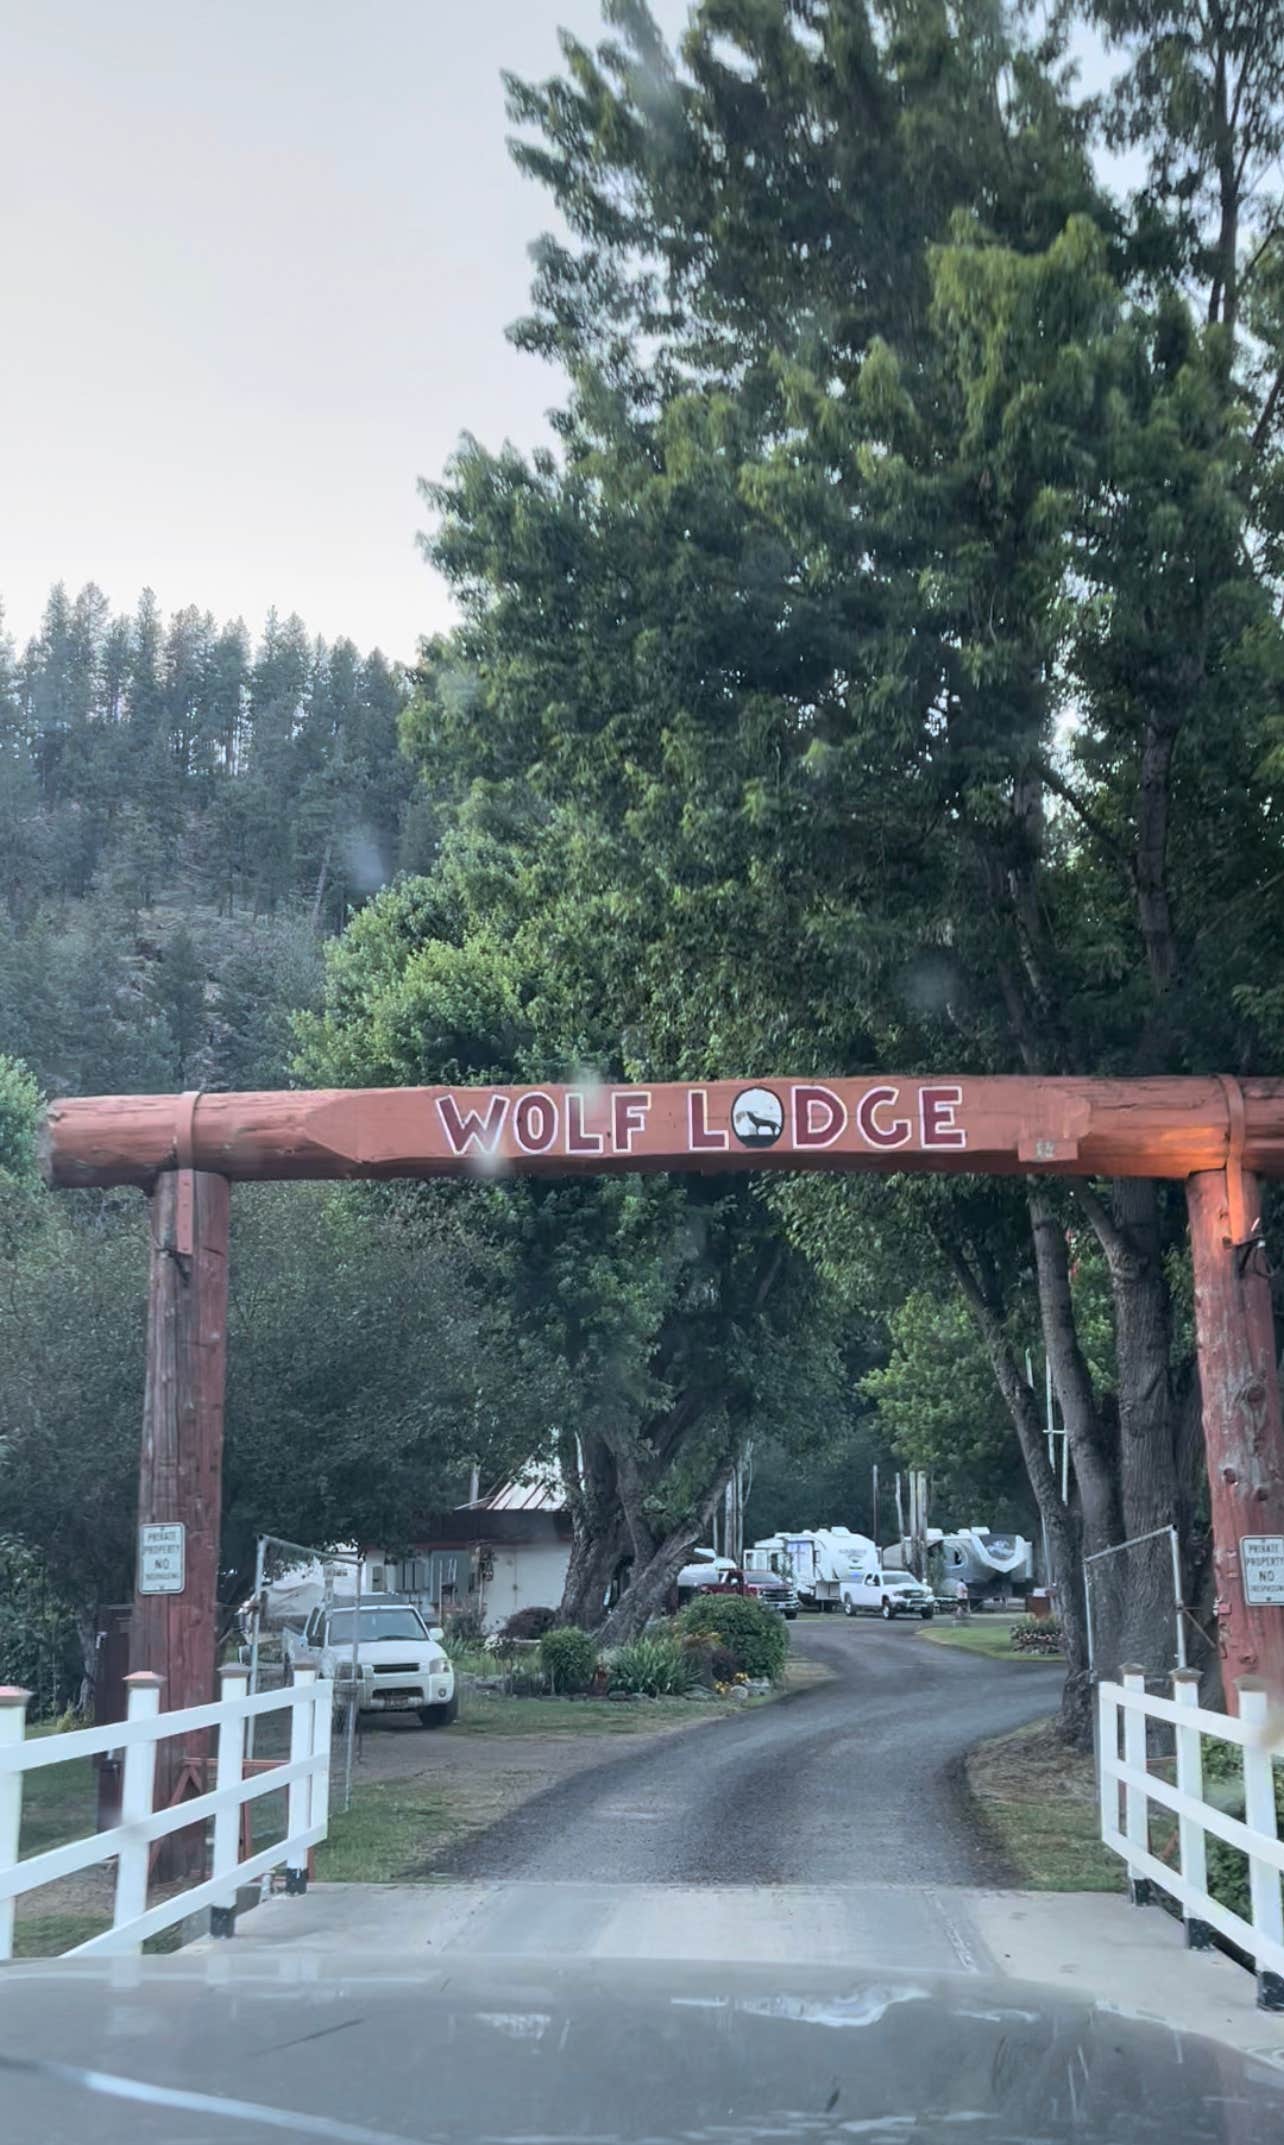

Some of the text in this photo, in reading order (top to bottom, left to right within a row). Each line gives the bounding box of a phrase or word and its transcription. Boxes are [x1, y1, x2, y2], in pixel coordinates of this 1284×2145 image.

[435, 1085, 967, 1155] WOLF LODGE
[155, 1558, 170, 1570] NO
[1259, 1570, 1275, 1582] NO
